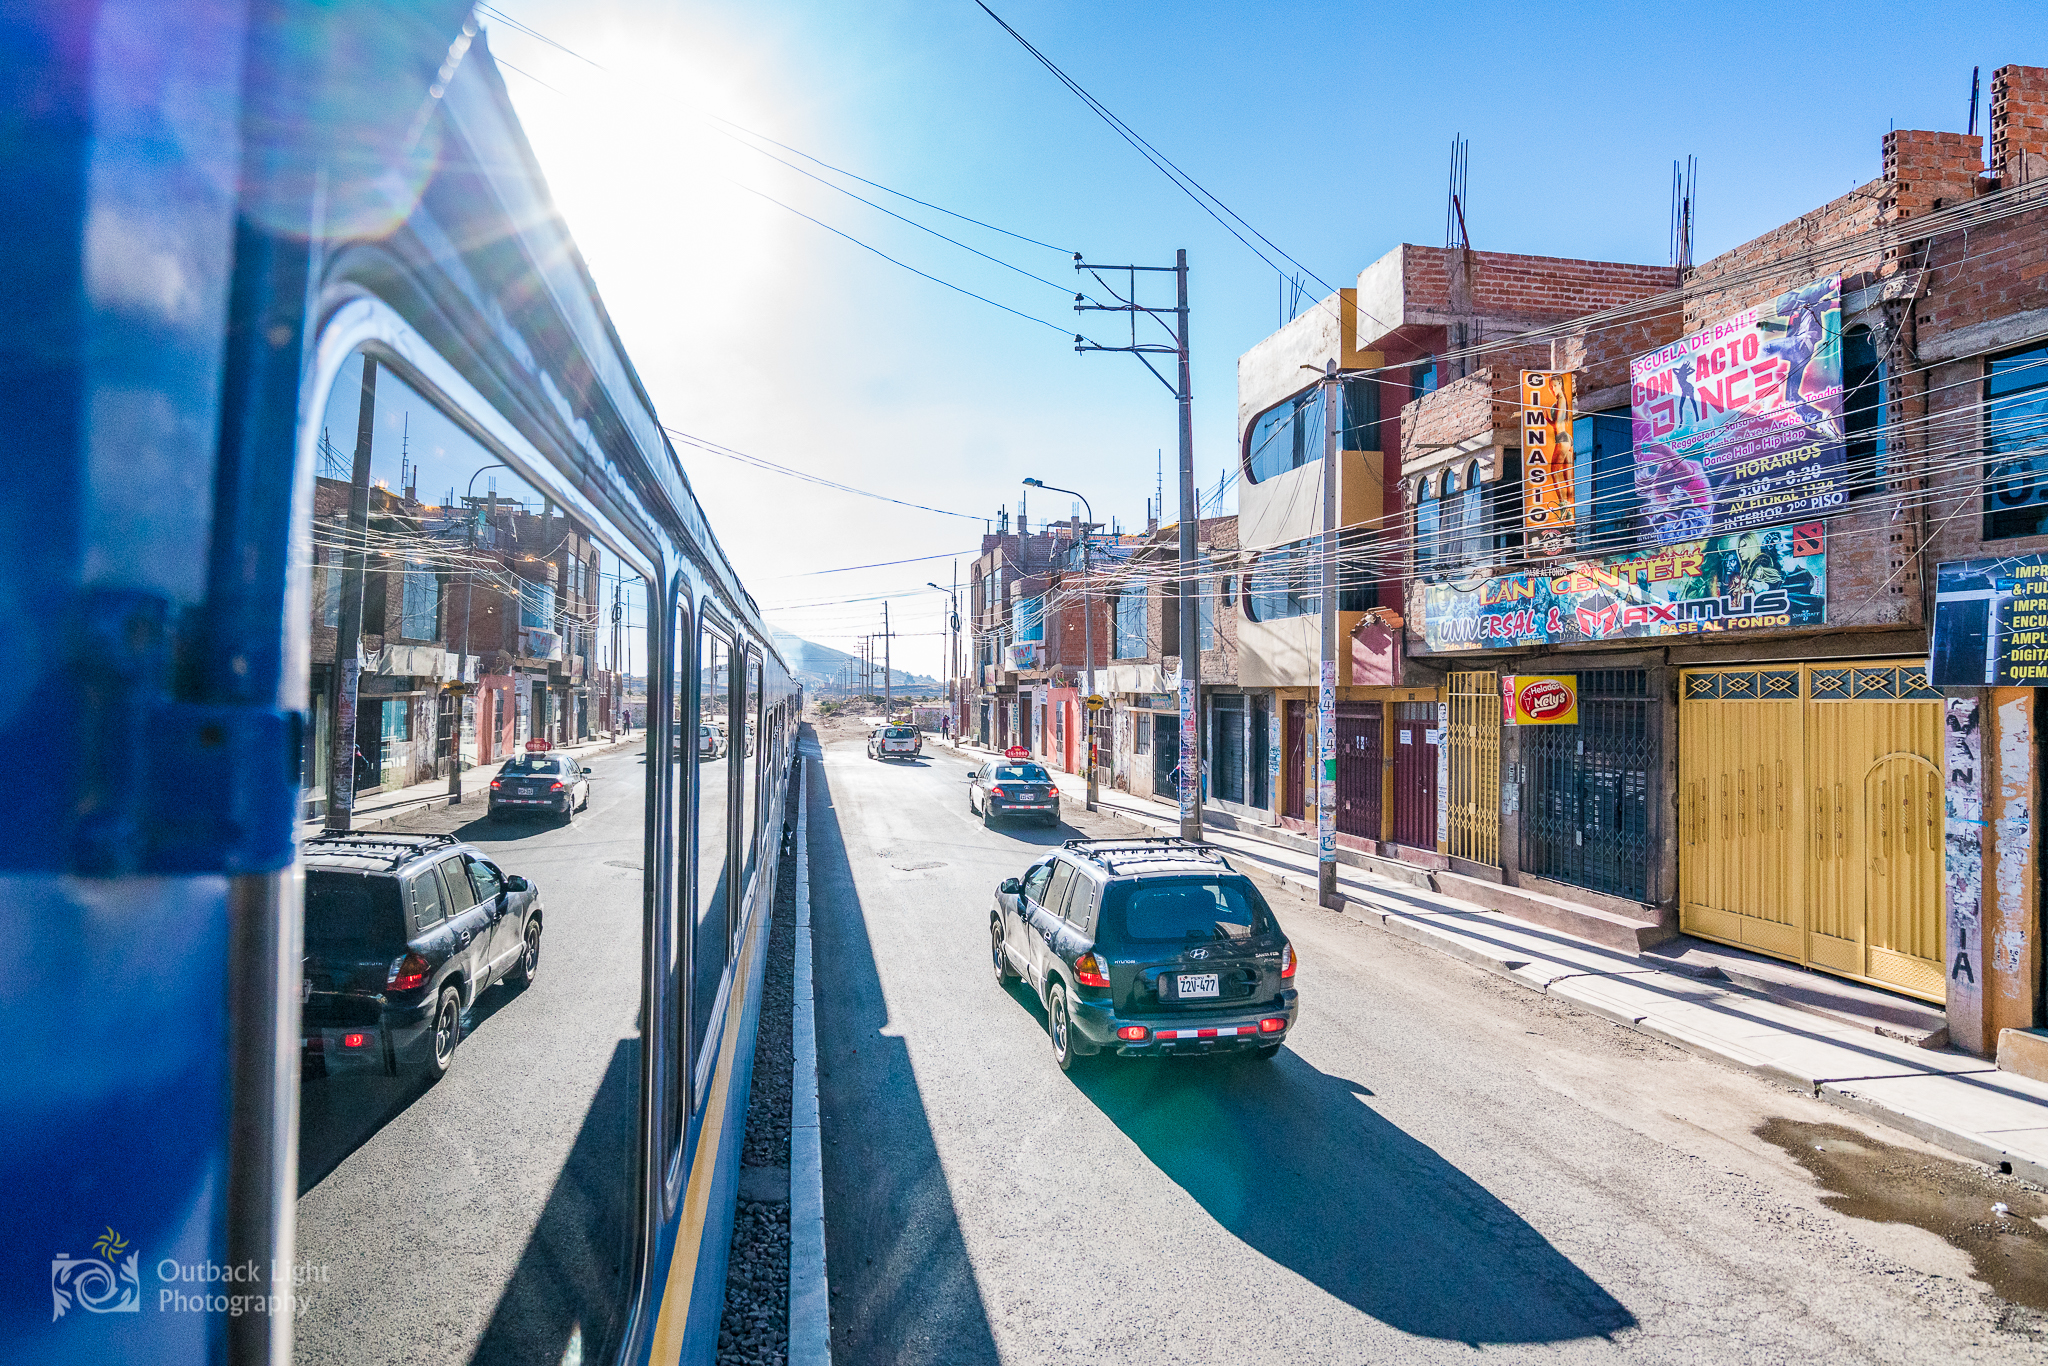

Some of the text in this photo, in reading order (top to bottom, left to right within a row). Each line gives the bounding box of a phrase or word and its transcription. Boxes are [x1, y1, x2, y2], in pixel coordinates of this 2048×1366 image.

[1631, 310, 1757, 378] ESCUELA DE BAILE
[1770, 415, 1801, 432] Arabe
[1526, 373, 1549, 523] GIMNASIO
[1703, 430, 1805, 467] Dance Hall Hip Hop
[1735, 442, 1822, 480] HORARIOS
[1723, 506, 1783, 530] INTERIOR
[1811, 492, 1843, 508] PISO
[1480, 548, 1704, 606] LAN CENTER
[2012, 583, 2022, 596] &
[2013, 598, 2048, 612] IMPR
[1440, 609, 1536, 642] UNIVERSAL
[1546, 606, 1563, 633] &
[1660, 614, 1791, 635] PASE AL FONDO
[2012, 615, 2048, 628] ENCU
[1463, 641, 1483, 650] Piso
[2011, 632, 2048, 645] AMPL
[2010, 665, 2048, 679] QUEM
[1530, 682, 1560, 695] Helados
